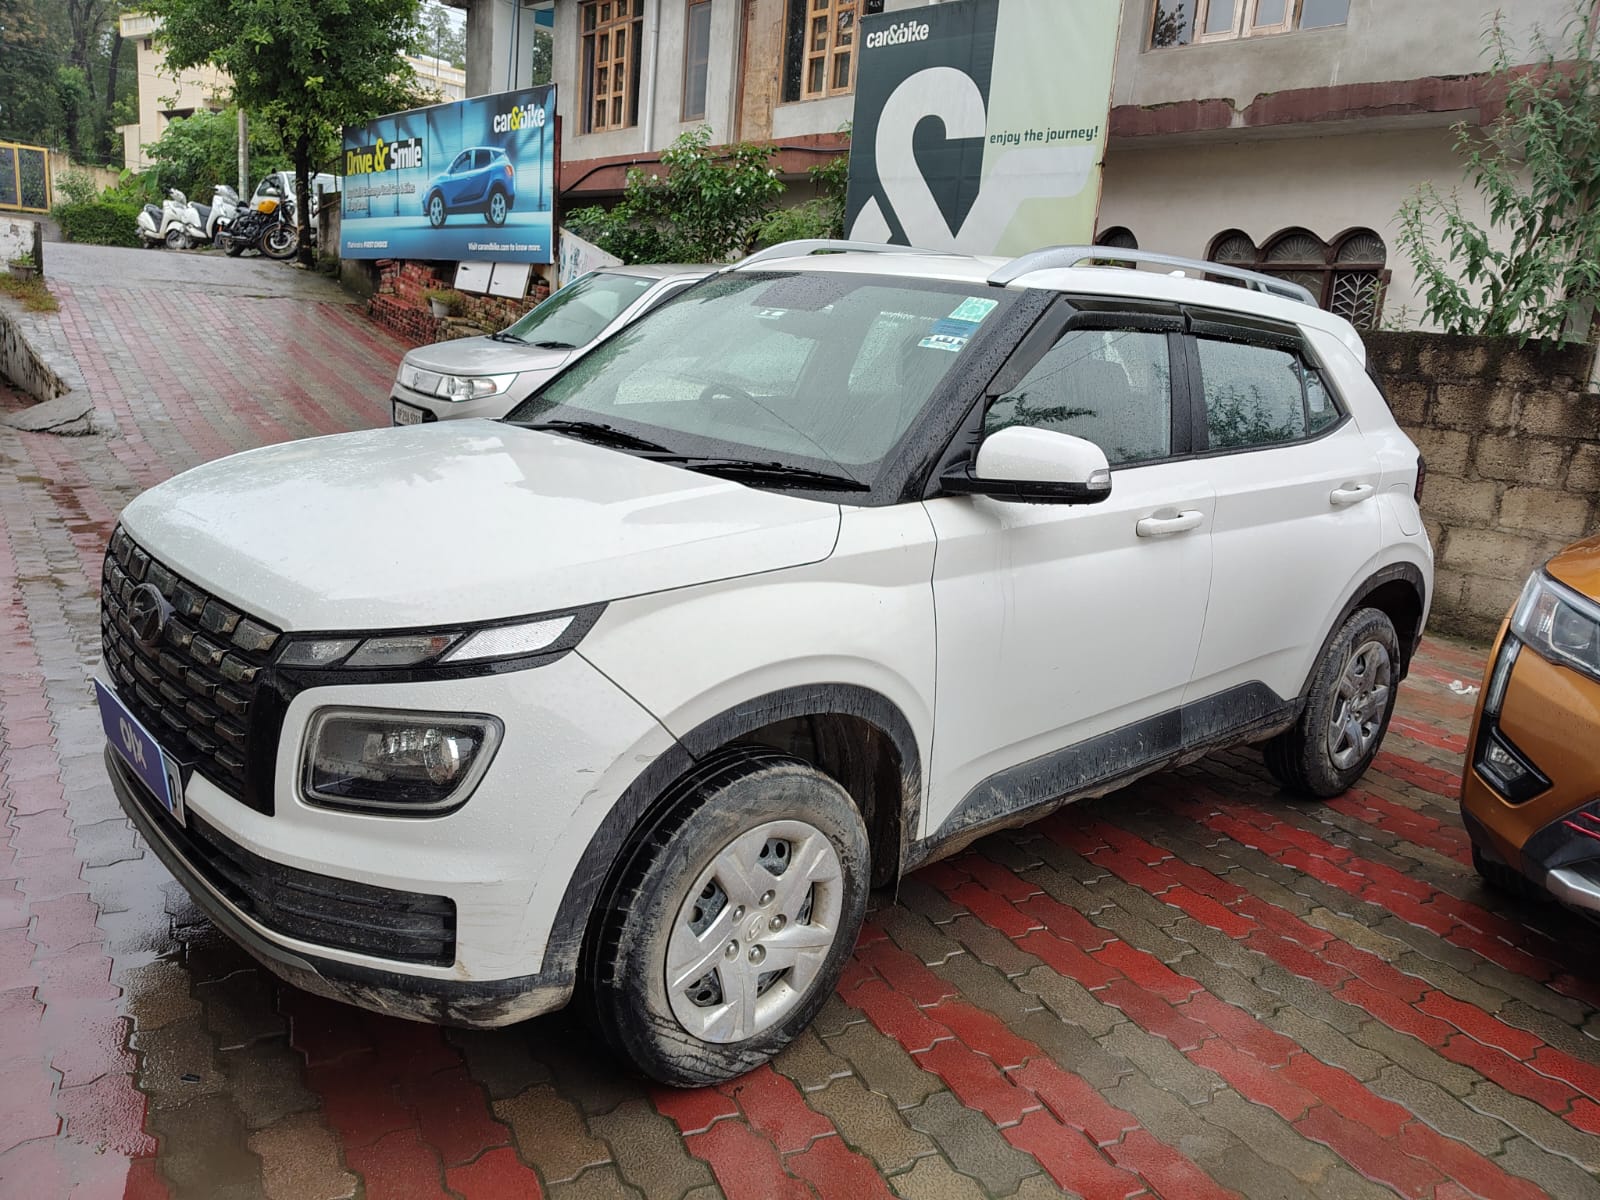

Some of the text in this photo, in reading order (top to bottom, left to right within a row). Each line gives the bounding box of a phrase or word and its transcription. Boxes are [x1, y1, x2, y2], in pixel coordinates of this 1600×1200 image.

[866, 20, 930, 48] car&bike
[493, 103, 545, 133] car&bike
[990, 125, 1099, 146] enjoy the journey!
[346, 137, 422, 176] Drive & Smile
